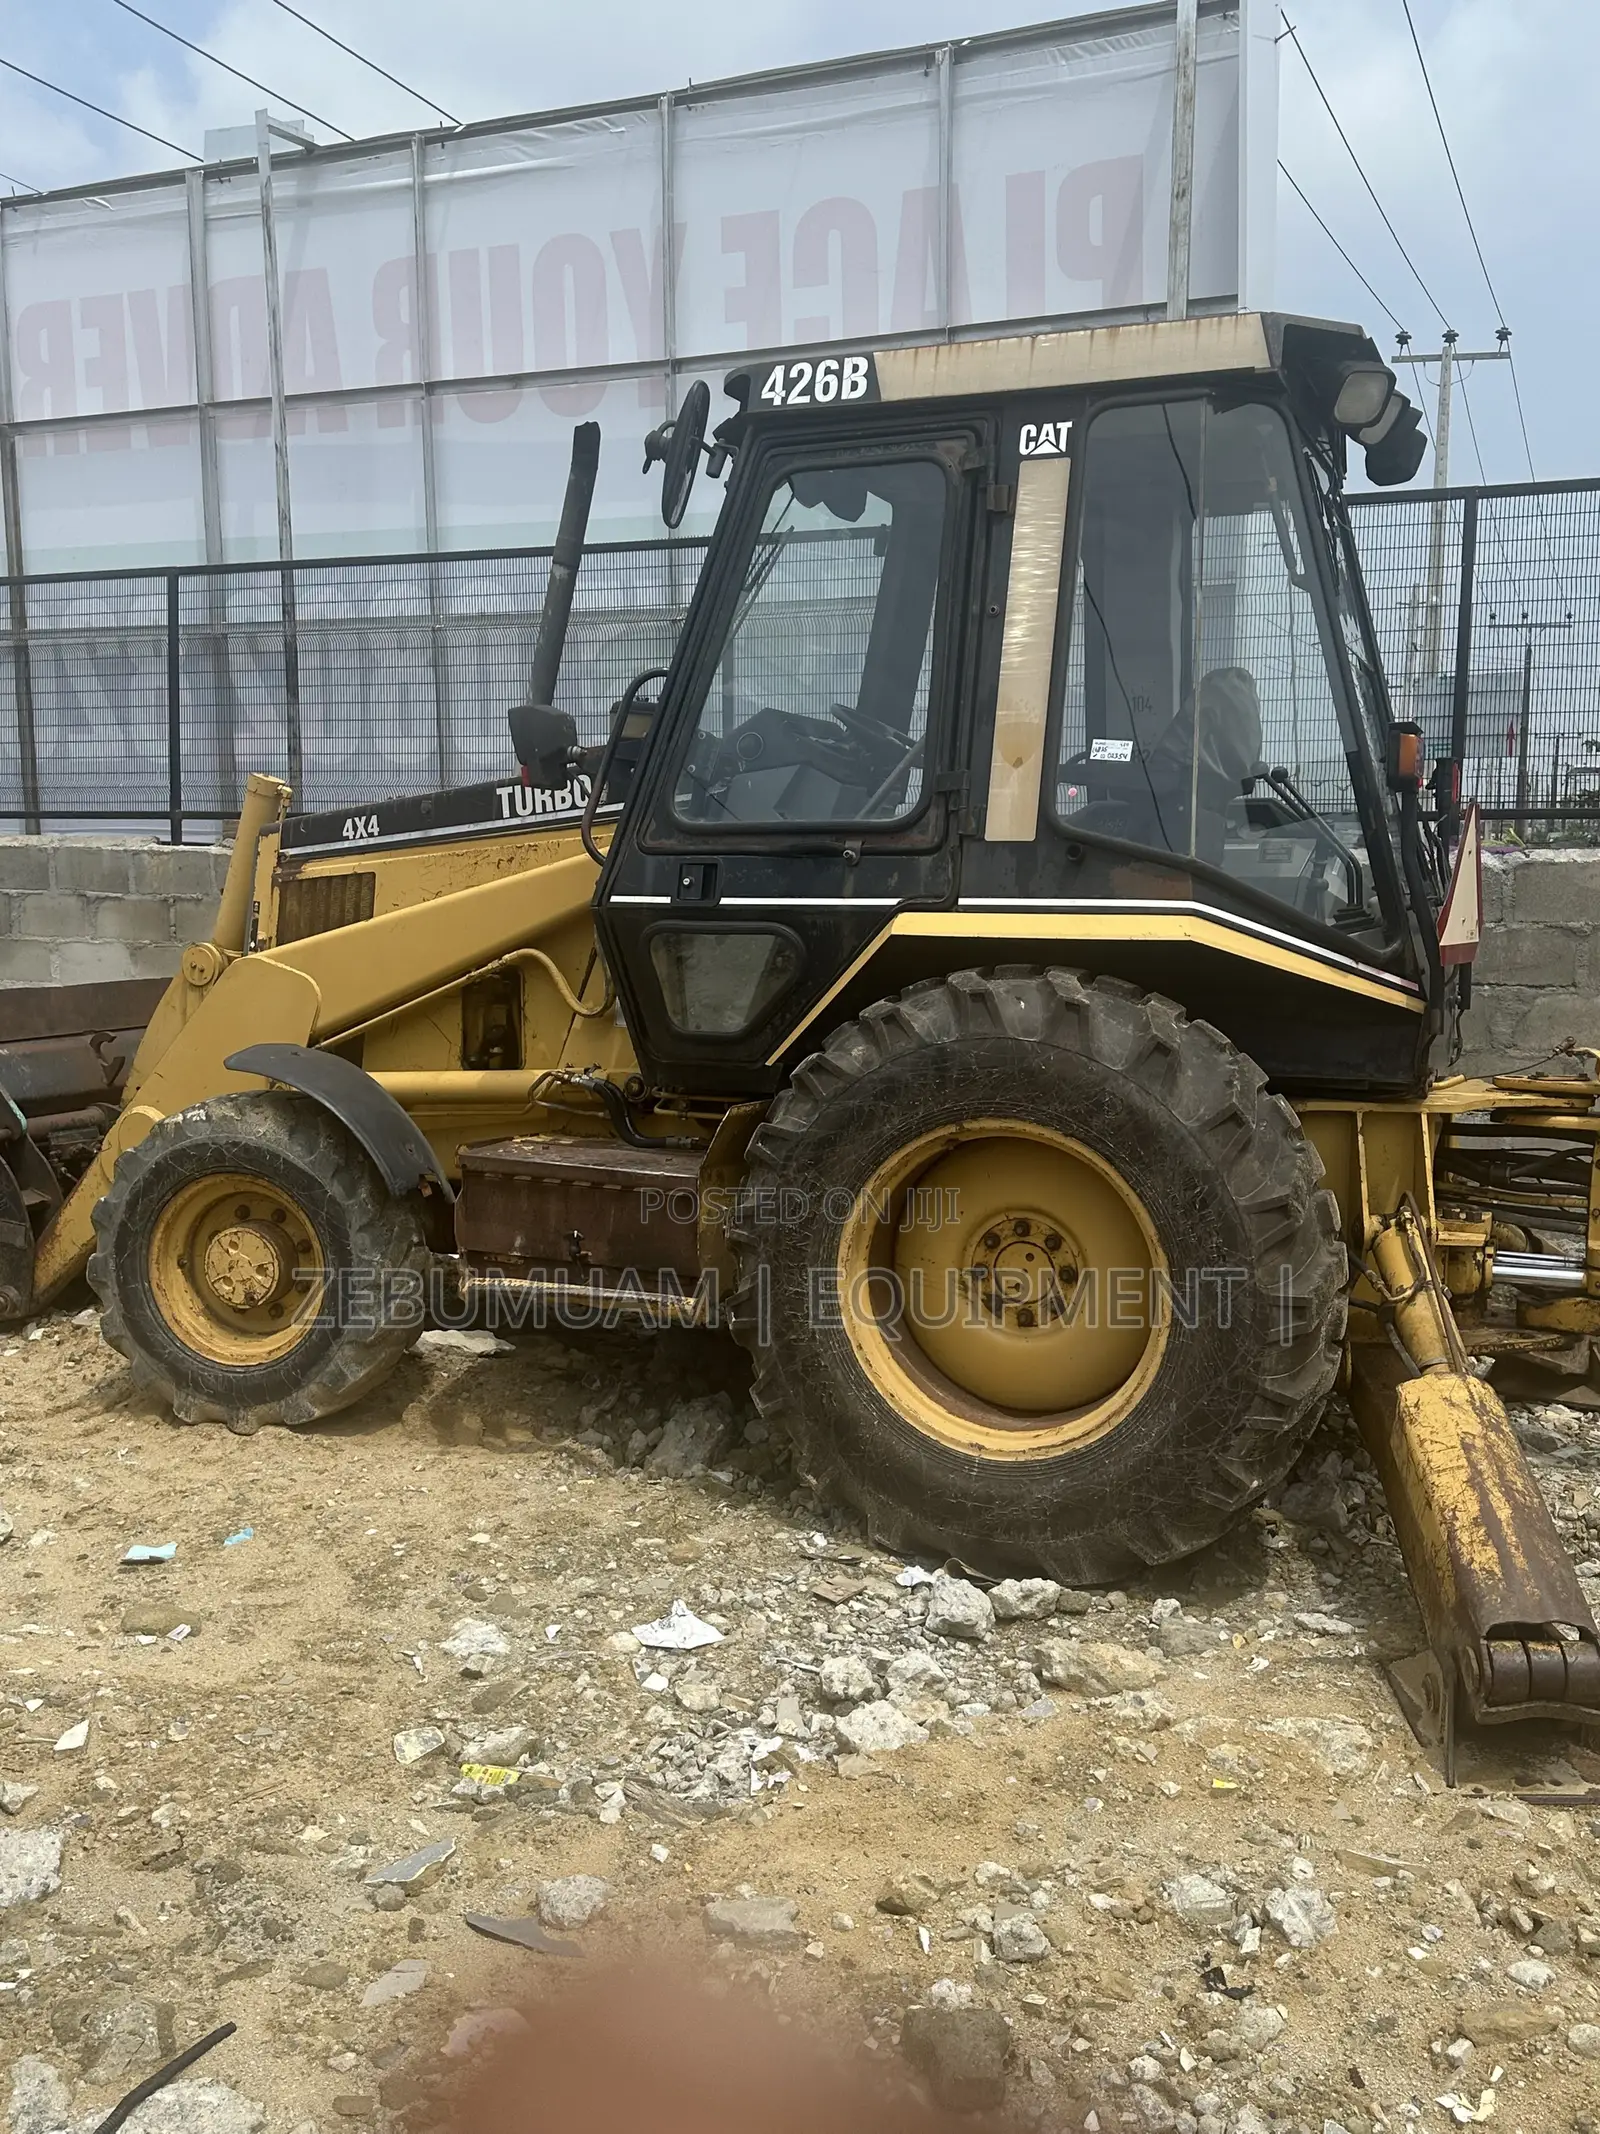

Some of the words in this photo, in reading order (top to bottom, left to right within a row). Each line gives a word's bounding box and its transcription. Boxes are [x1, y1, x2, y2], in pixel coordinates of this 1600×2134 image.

[761, 356, 870, 406] 426B
[1018, 420, 1073, 456] CAT
[496, 774, 592, 818] TURBO
[342, 815, 379, 840] 4X4
